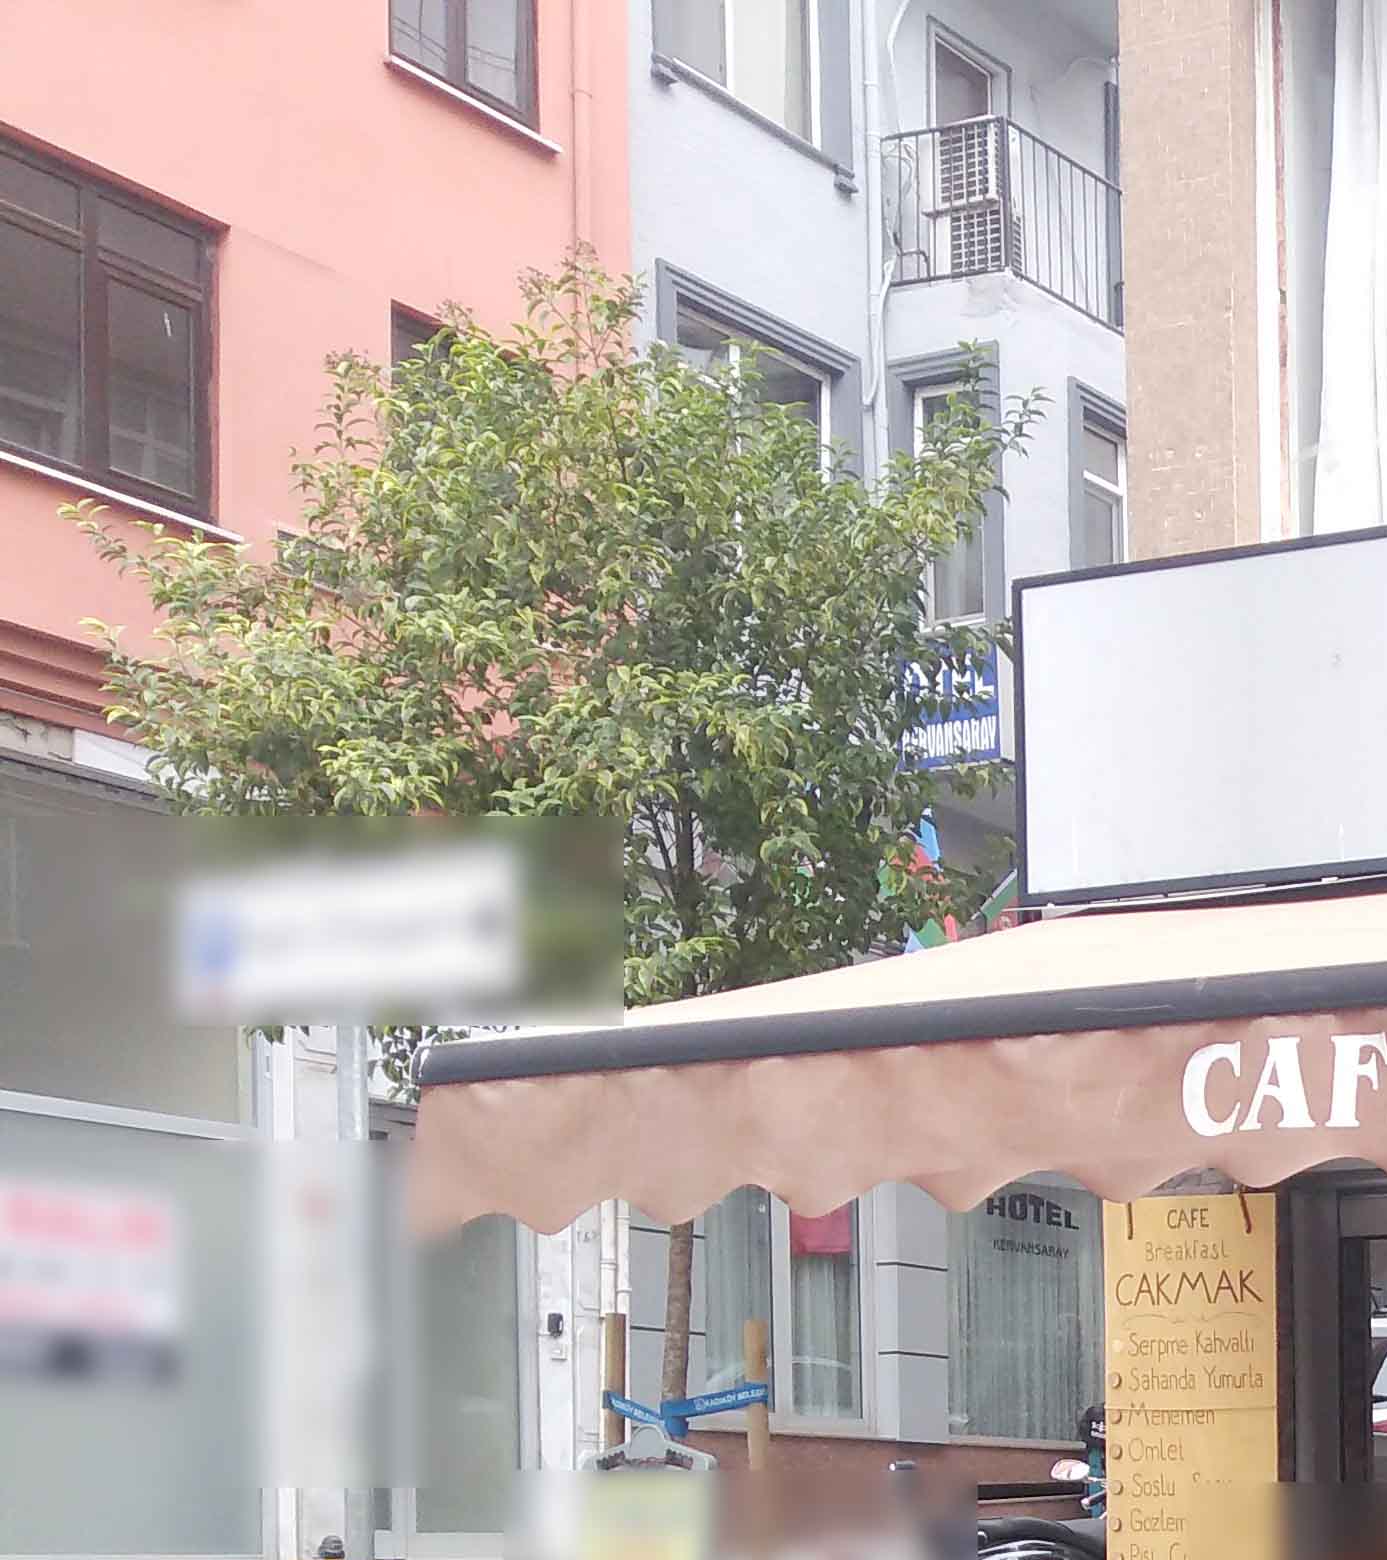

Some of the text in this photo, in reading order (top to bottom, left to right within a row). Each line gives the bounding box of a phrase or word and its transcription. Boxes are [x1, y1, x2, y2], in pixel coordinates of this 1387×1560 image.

[986, 1192, 1080, 1231] HOTEL
[1166, 1207, 1210, 1230] CAFE
[1127, 1331, 1189, 1363] Serpme
[1127, 1366, 1196, 1392] Sahanda
[1127, 1436, 1185, 1462] Omlet
